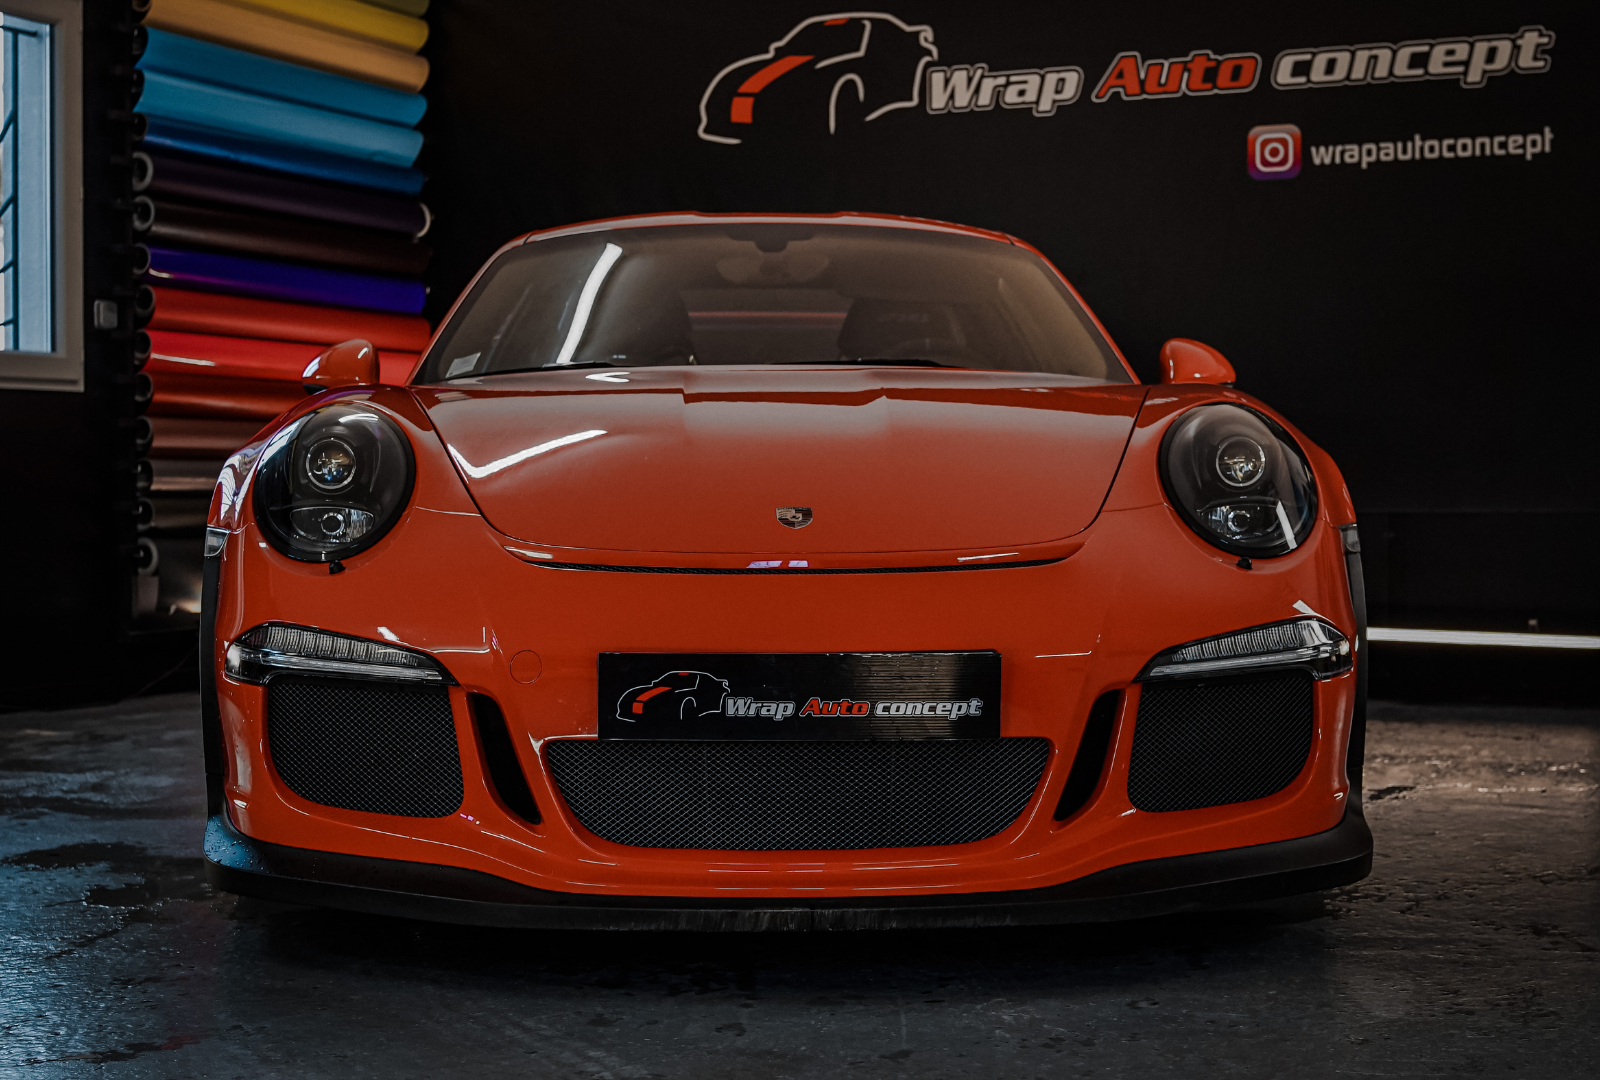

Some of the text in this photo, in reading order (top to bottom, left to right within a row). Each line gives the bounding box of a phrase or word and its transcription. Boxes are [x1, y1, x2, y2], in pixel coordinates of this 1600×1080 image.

[927, 25, 1555, 116] Wrap Auto concept
[1310, 127, 1554, 169] wrapautoconcept
[725, 696, 984, 721] Wrap Auto concept
